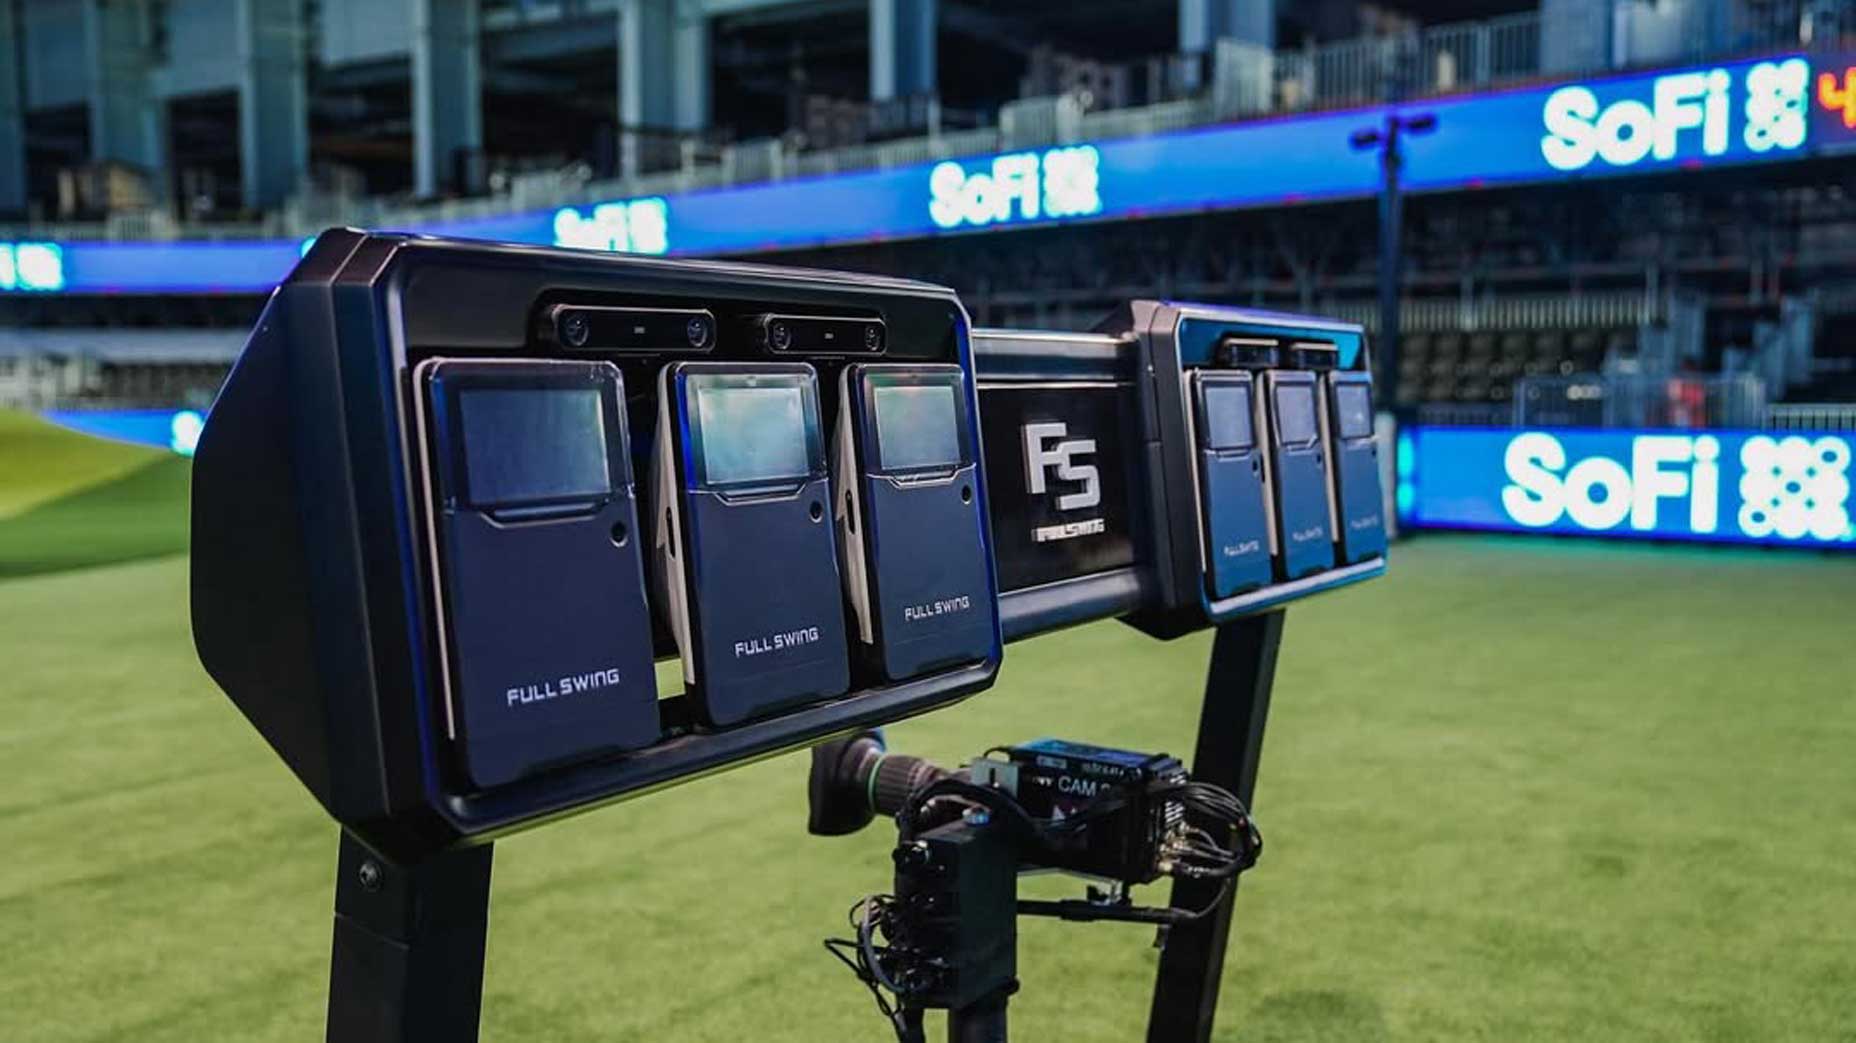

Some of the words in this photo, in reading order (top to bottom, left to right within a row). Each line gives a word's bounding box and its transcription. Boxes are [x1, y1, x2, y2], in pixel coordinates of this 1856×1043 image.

[1541, 67, 1731, 171] SoFi
[929, 152, 1040, 227] SoFi
[1021, 422, 1101, 511] FS
[1502, 431, 1720, 534] SoFi
[904, 605, 934, 621] FULL
[935, 595, 970, 615] SWING
[735, 638, 773, 658] FULL
[774, 626, 819, 648] SWING
[506, 682, 558, 707] FULL
[559, 668, 620, 695] SWING
[1058, 775, 1097, 797] CAM
